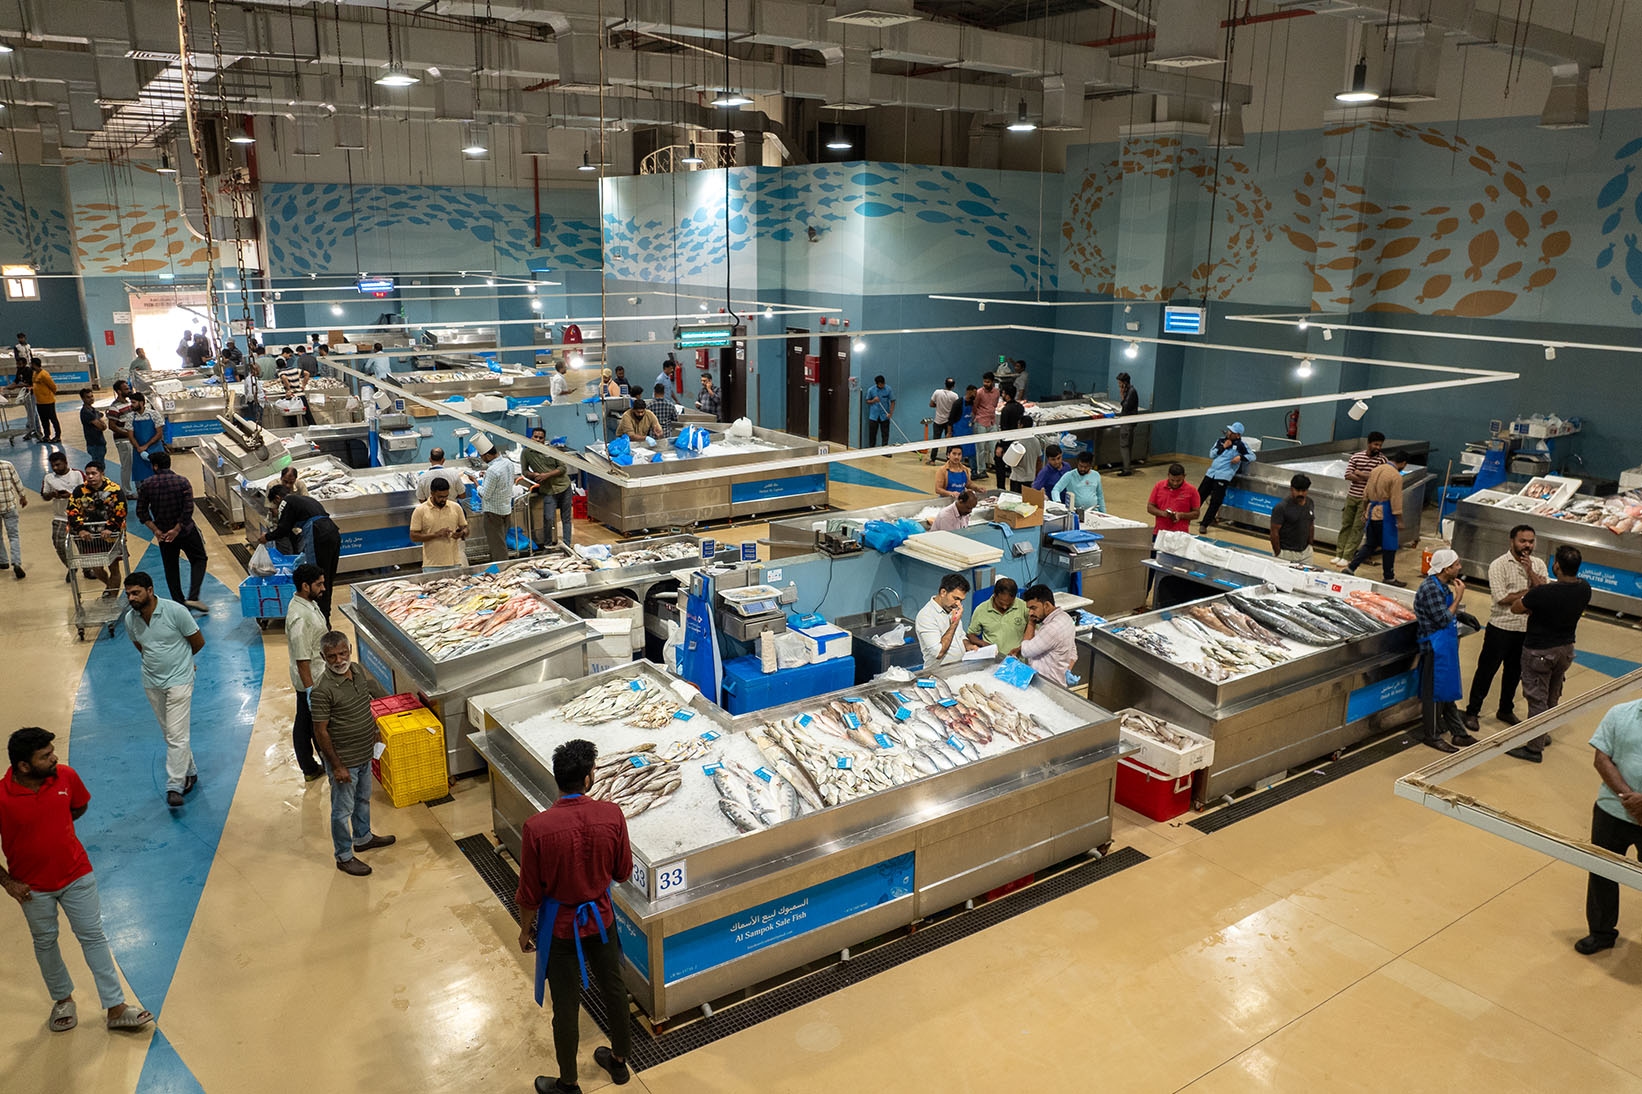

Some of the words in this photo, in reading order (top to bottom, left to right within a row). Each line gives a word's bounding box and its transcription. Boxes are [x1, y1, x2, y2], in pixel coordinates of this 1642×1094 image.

[633, 864, 646, 888] 33
[660, 868, 683, 890] 33
[761, 908, 776, 924] لبيع
[777, 897, 809, 916] السمبوك
[730, 915, 760, 933] الأسماك
[735, 933, 744, 943] Al
[744, 923, 774, 940] Sampok
[775, 917, 791, 929] Sale
[792, 911, 807, 922] Fish
